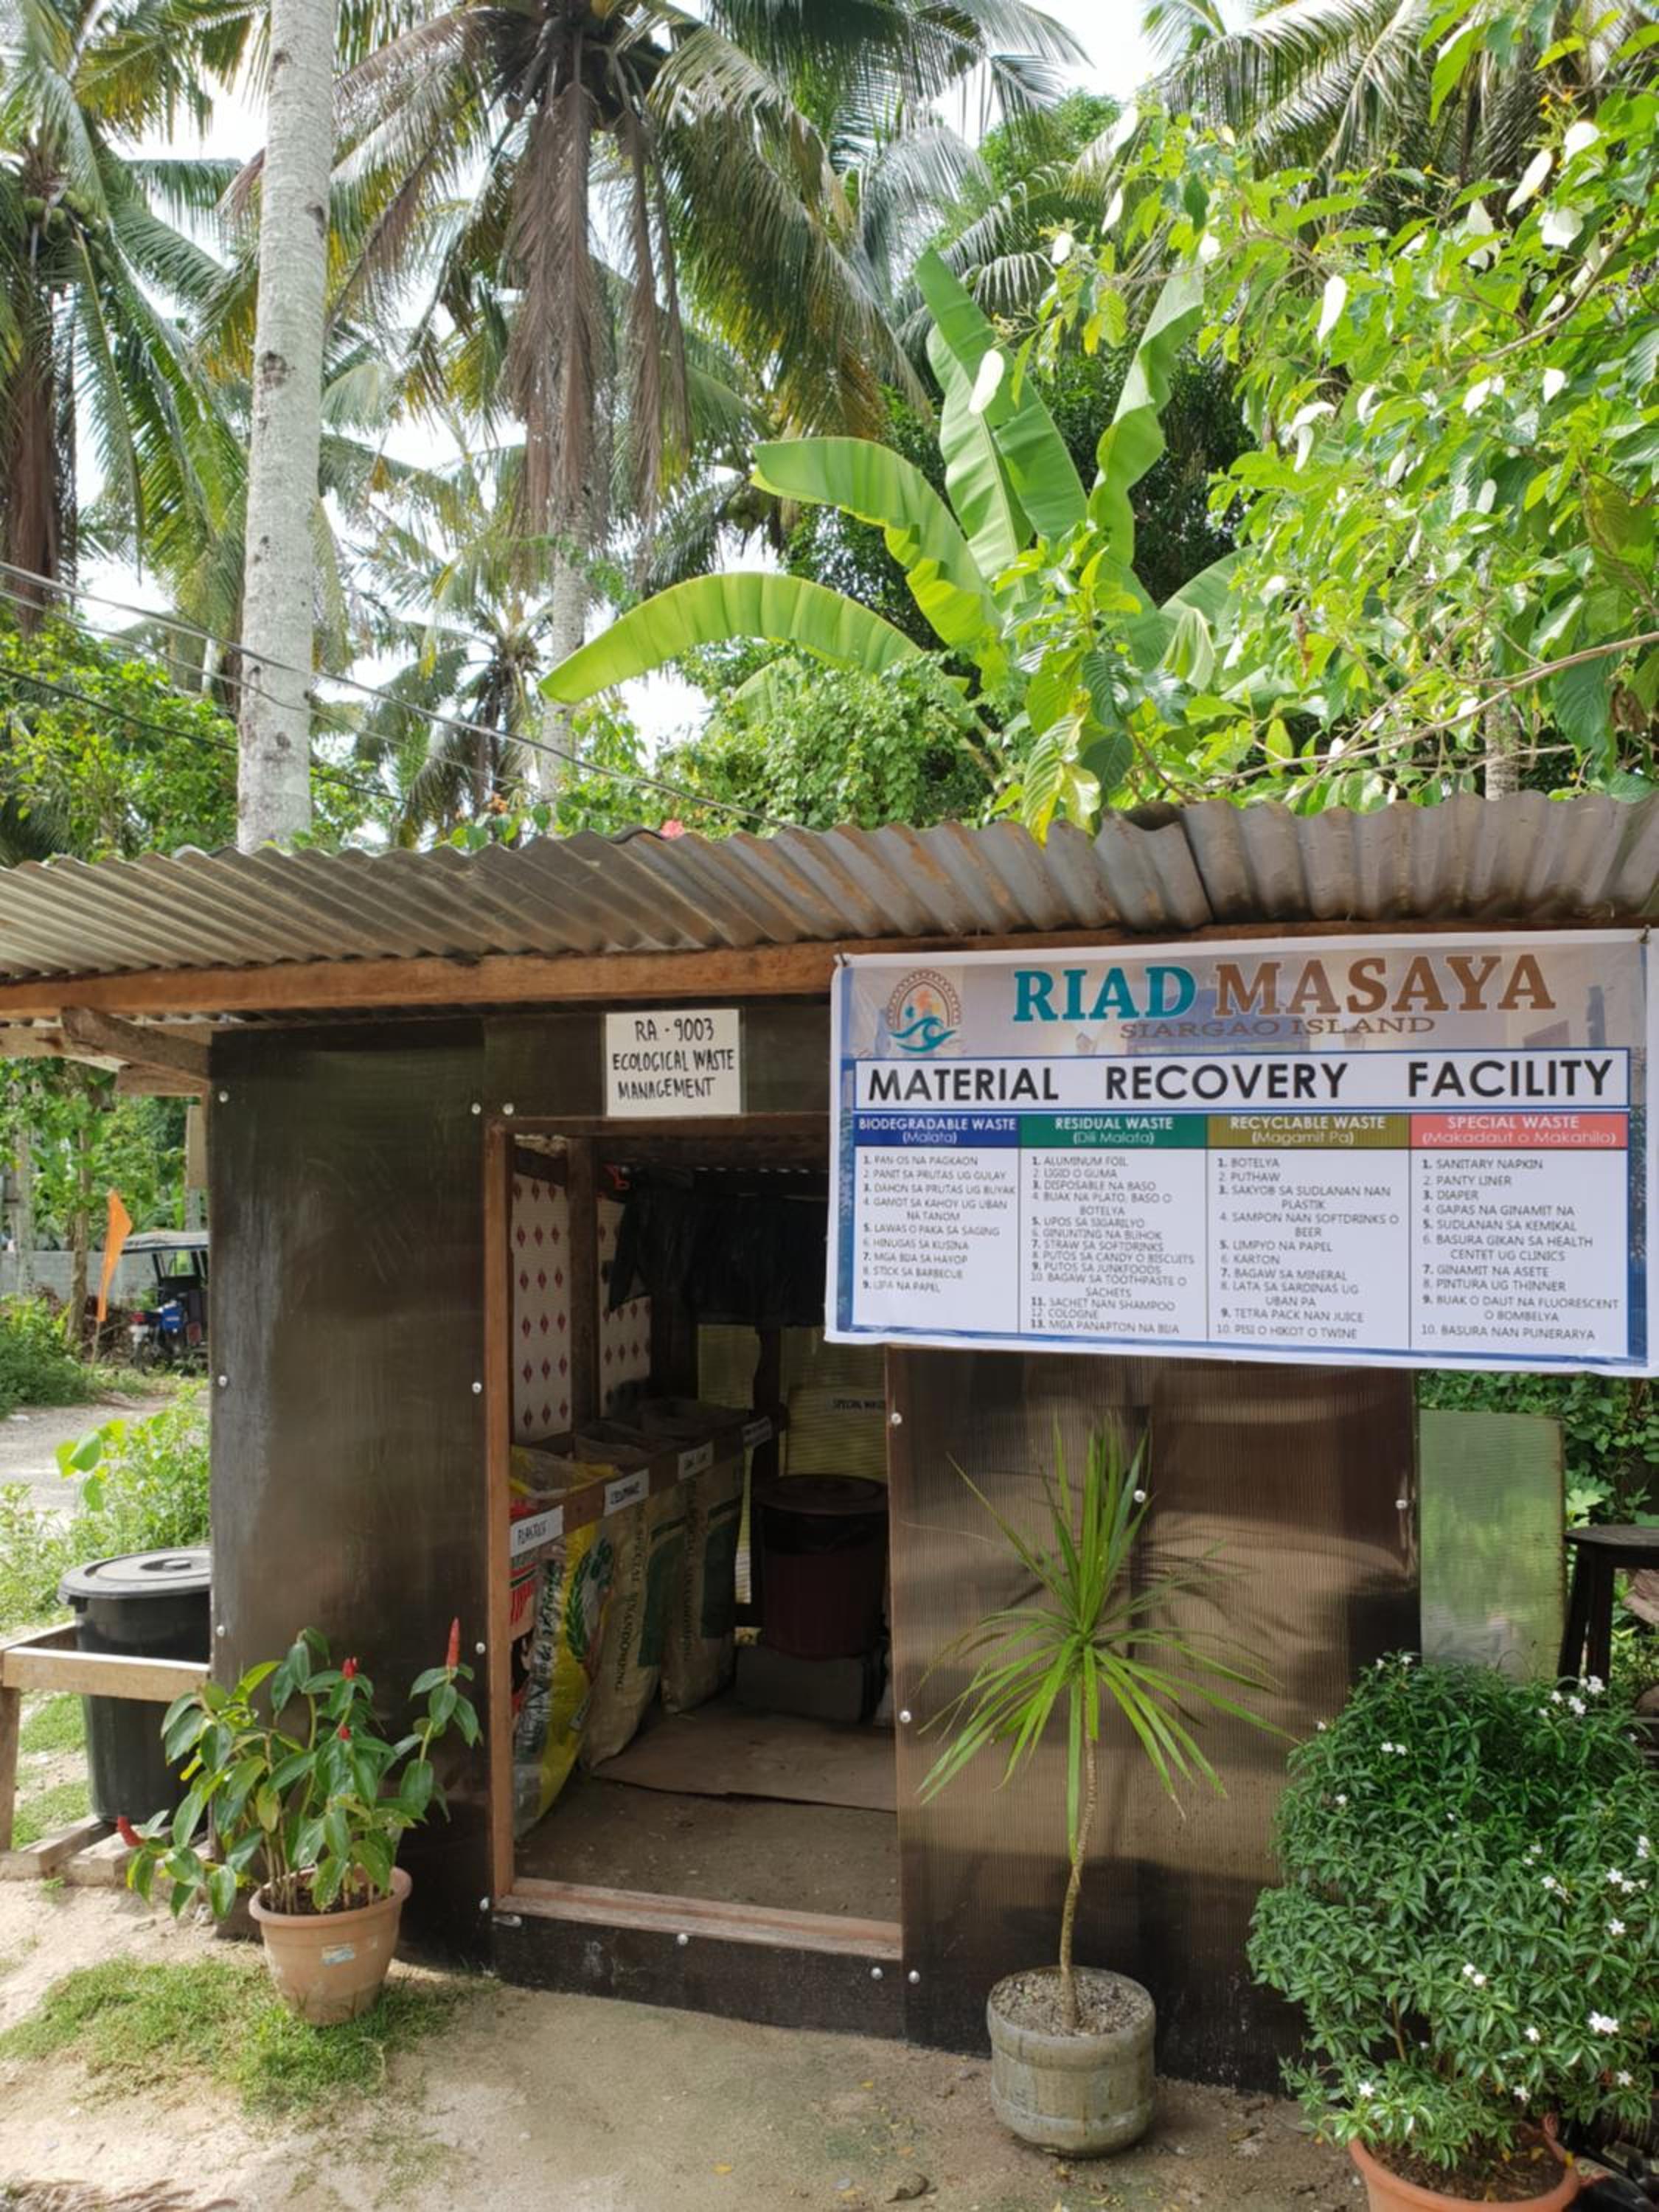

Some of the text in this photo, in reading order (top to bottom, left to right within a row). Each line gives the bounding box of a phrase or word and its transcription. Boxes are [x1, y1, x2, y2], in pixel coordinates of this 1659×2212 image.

[1013, 953, 1556, 1021] RIAD MASAYA
[635, 1018, 658, 1041] RA
[674, 1017, 714, 1042] 9003
[1121, 1017, 1436, 1038] SIARGAO ISLAND
[613, 1048, 734, 1071] ECOLOGICAL WASTE
[869, 1060, 1613, 1101] MATERIAL RECOVERY FACILITY
[618, 1077, 716, 1099] MANAGEMENT
[859, 1119, 1016, 1130] BIODEGRADABLE WASTE
[1055, 1118, 1173, 1130] RESIDUAL WASTE
[1231, 1116, 1385, 1129] RECYCLABLE WASTE
[1447, 1116, 1579, 1129] SPECIAL WASTE
[902, 1133, 957, 1144] (Malata)
[1329, 1132, 1354, 1144] Pa)
[1518, 1134, 1529, 1143] o
[1231, 1158, 1280, 1168] BOTELYA
[1436, 1159, 1543, 1169] SANITARY NAPKIN
[1073, 1169, 1081, 1178] O
[1231, 1172, 1281, 1182] PUTHAW
[1108, 1181, 1124, 1191] NA
[1436, 1176, 1512, 1186] PANTY LINER
[1279, 1186, 1293, 1196] SA
[1297, 1186, 1360, 1197] SUDLANAN
[1364, 1186, 1391, 1197] NAN
[1437, 1190, 1478, 1200] DIAPER
[1074, 1193, 1089, 1202] NA
[1163, 1194, 1172, 1203] O
[1281, 1199, 1325, 1210] PLASTIK
[1436, 1205, 1575, 1216] GAPAS NA GINAMIT NA
[1075, 1218, 1088, 1227] SA
[1286, 1214, 1311, 1224] NAN
[1315, 1214, 1386, 1225] SOFTDRINKS
[1389, 1215, 1399, 1225] O
[1437, 1220, 1577, 1232] SUDLANAN SA KEMIKAL
[1106, 1230, 1121, 1239] NA
[1295, 1227, 1321, 1237] BEER
[1082, 1241, 1096, 1251] SA
[1233, 1240, 1332, 1252] LIMPYO NA PAPEL
[1436, 1235, 1593, 1248] BASURA GIKAN SA HEALTH
[1080, 1253, 1093, 1262] SA
[1135, 1254, 1144, 1263] O
[1233, 1254, 1280, 1265] KARTON
[1498, 1251, 1515, 1261] UG
[1519, 1251, 1565, 1262] CLINICS
[1082, 1264, 1094, 1273] SA
[1437, 1265, 1549, 1277] GINAMIT NA ASETE
[1089, 1274, 1102, 1284] SA
[1178, 1277, 1186, 1286] O
[1234, 1268, 1347, 1281] BAGAW SA MINERAL
[1233, 1281, 1358, 1295] LATA SA SARDINAS UG
[1437, 1279, 1566, 1292] PINTURA UG THINNER
[1091, 1298, 1116, 1309] NAN
[1301, 1296, 1315, 1307] PA
[1470, 1295, 1480, 1306] O
[1482, 1296, 1512, 1307] DAUT
[1517, 1297, 1534, 1308] NA
[1538, 1297, 1618, 1310] FLUORESCENT
[1235, 1308, 1364, 1323] TETRA PACK NAN JUICE
[1484, 1310, 1559, 1322] O BOMBELYA
[1258, 1325, 1267, 1335] O
[1308, 1327, 1317, 1337] O
[1321, 1327, 1357, 1339] TWINE
[1441, 1325, 1487, 1336] BASURA
[1492, 1326, 1519, 1338] NAN
